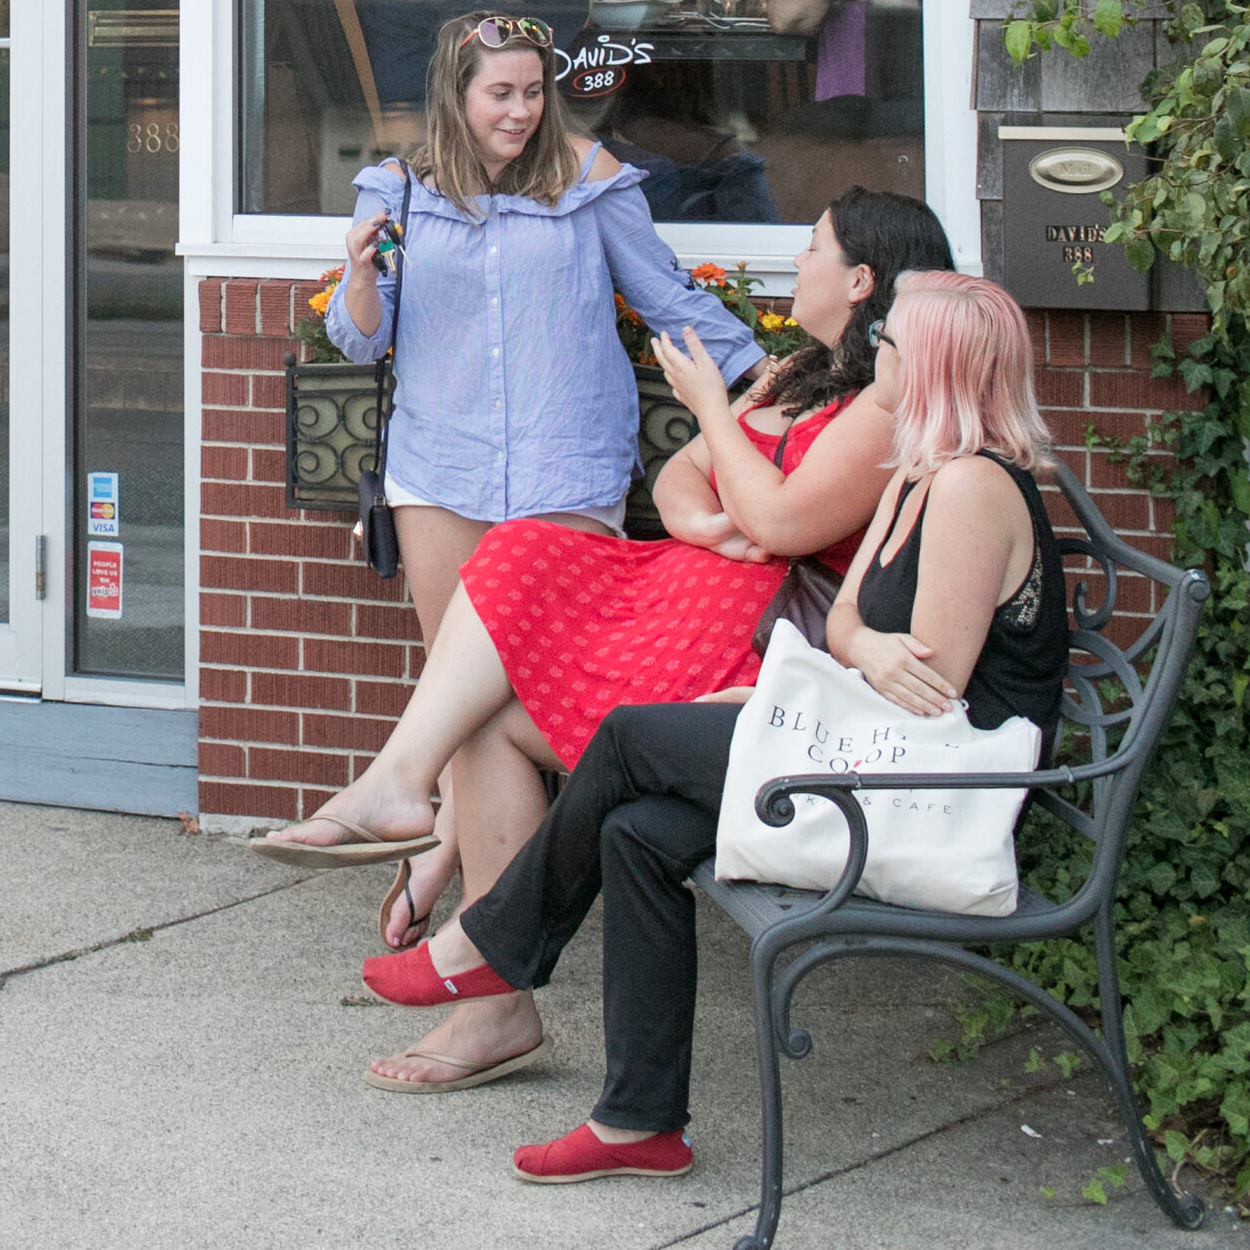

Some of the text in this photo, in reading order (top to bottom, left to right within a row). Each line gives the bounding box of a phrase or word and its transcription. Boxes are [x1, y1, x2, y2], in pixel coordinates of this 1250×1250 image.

[583, 70, 615, 92] 388
[127, 122, 180, 154] 388
[1047, 224, 1107, 242] DAVID'S
[1064, 247, 1093, 262] 388
[93, 523, 115, 532] VISA
[768, 705, 853, 753] BLUE
[892, 798, 953, 815] CAFE
